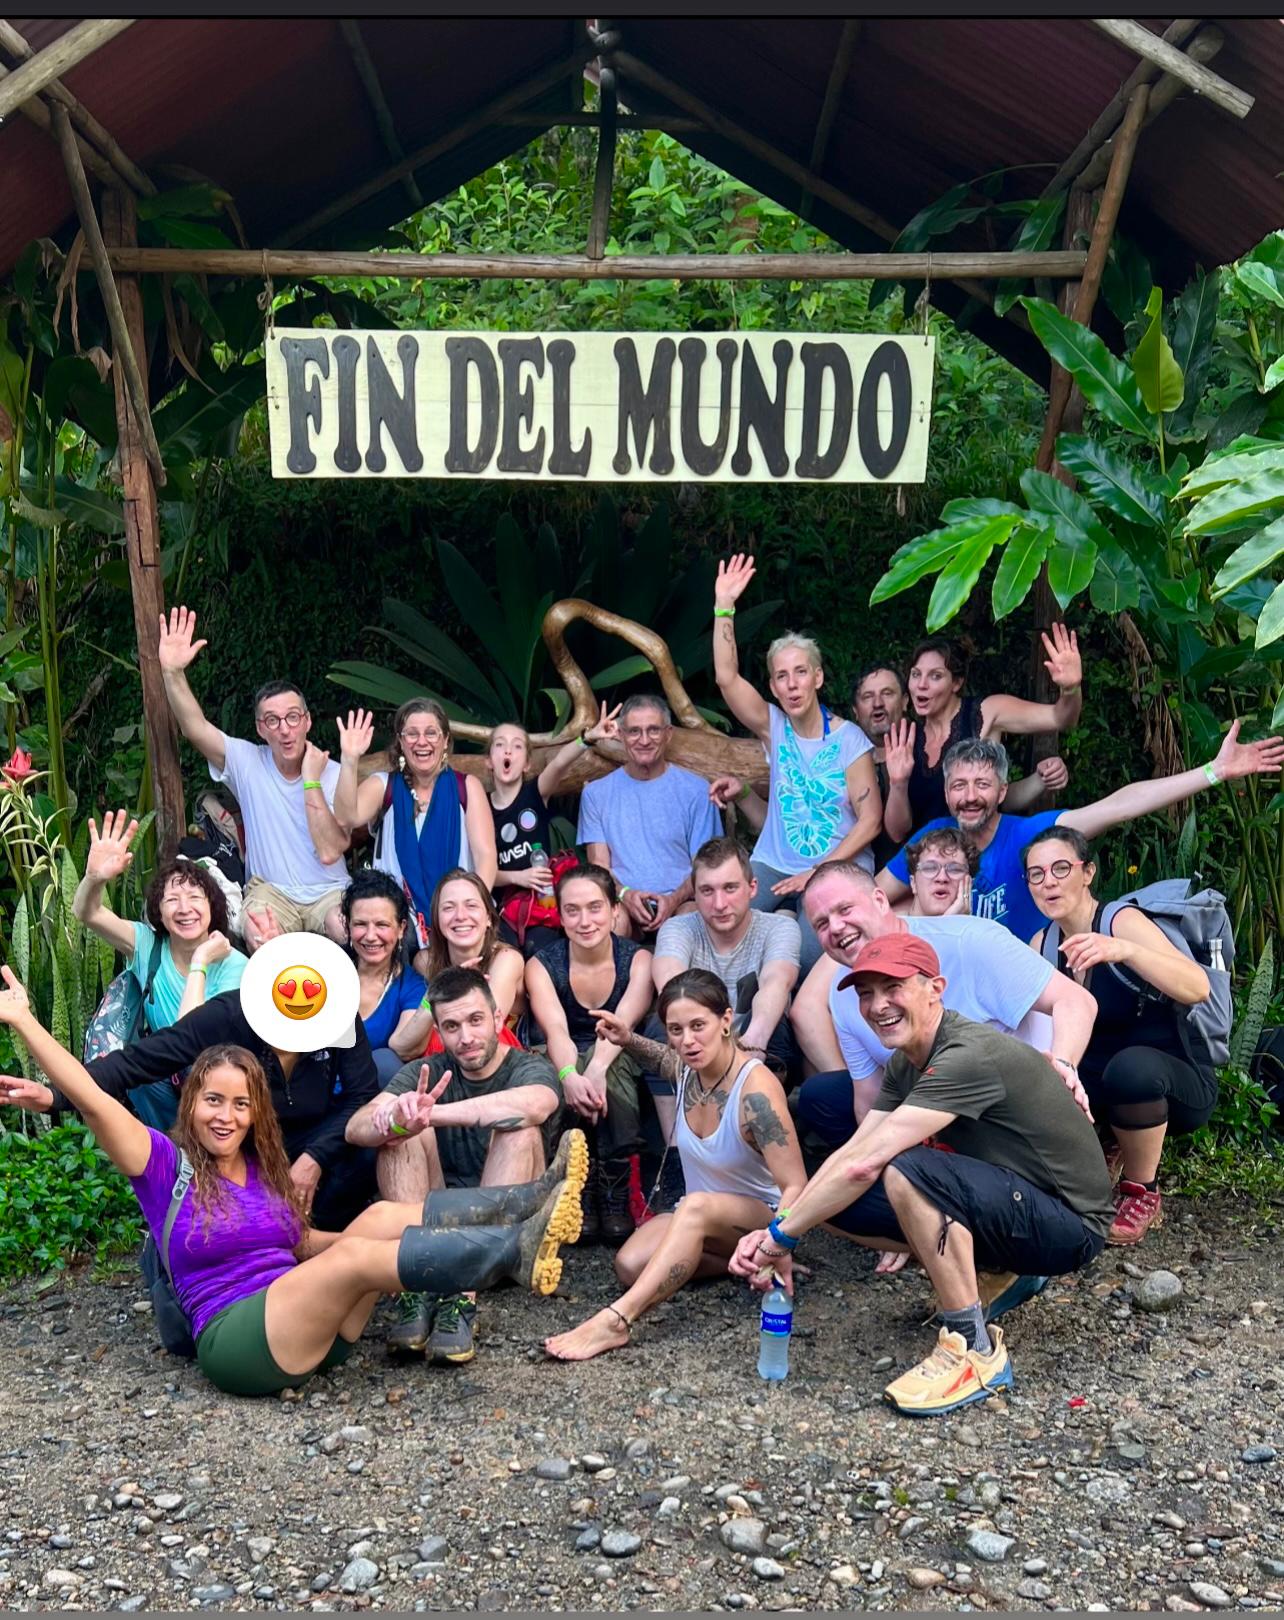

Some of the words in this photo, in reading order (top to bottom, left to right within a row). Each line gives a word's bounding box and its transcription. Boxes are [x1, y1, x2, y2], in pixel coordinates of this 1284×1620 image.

[281, 334, 424, 474] FIN
[446, 336, 592, 477] DEL
[613, 337, 913, 480] MUNDO
[499, 841, 533, 865] NASA
